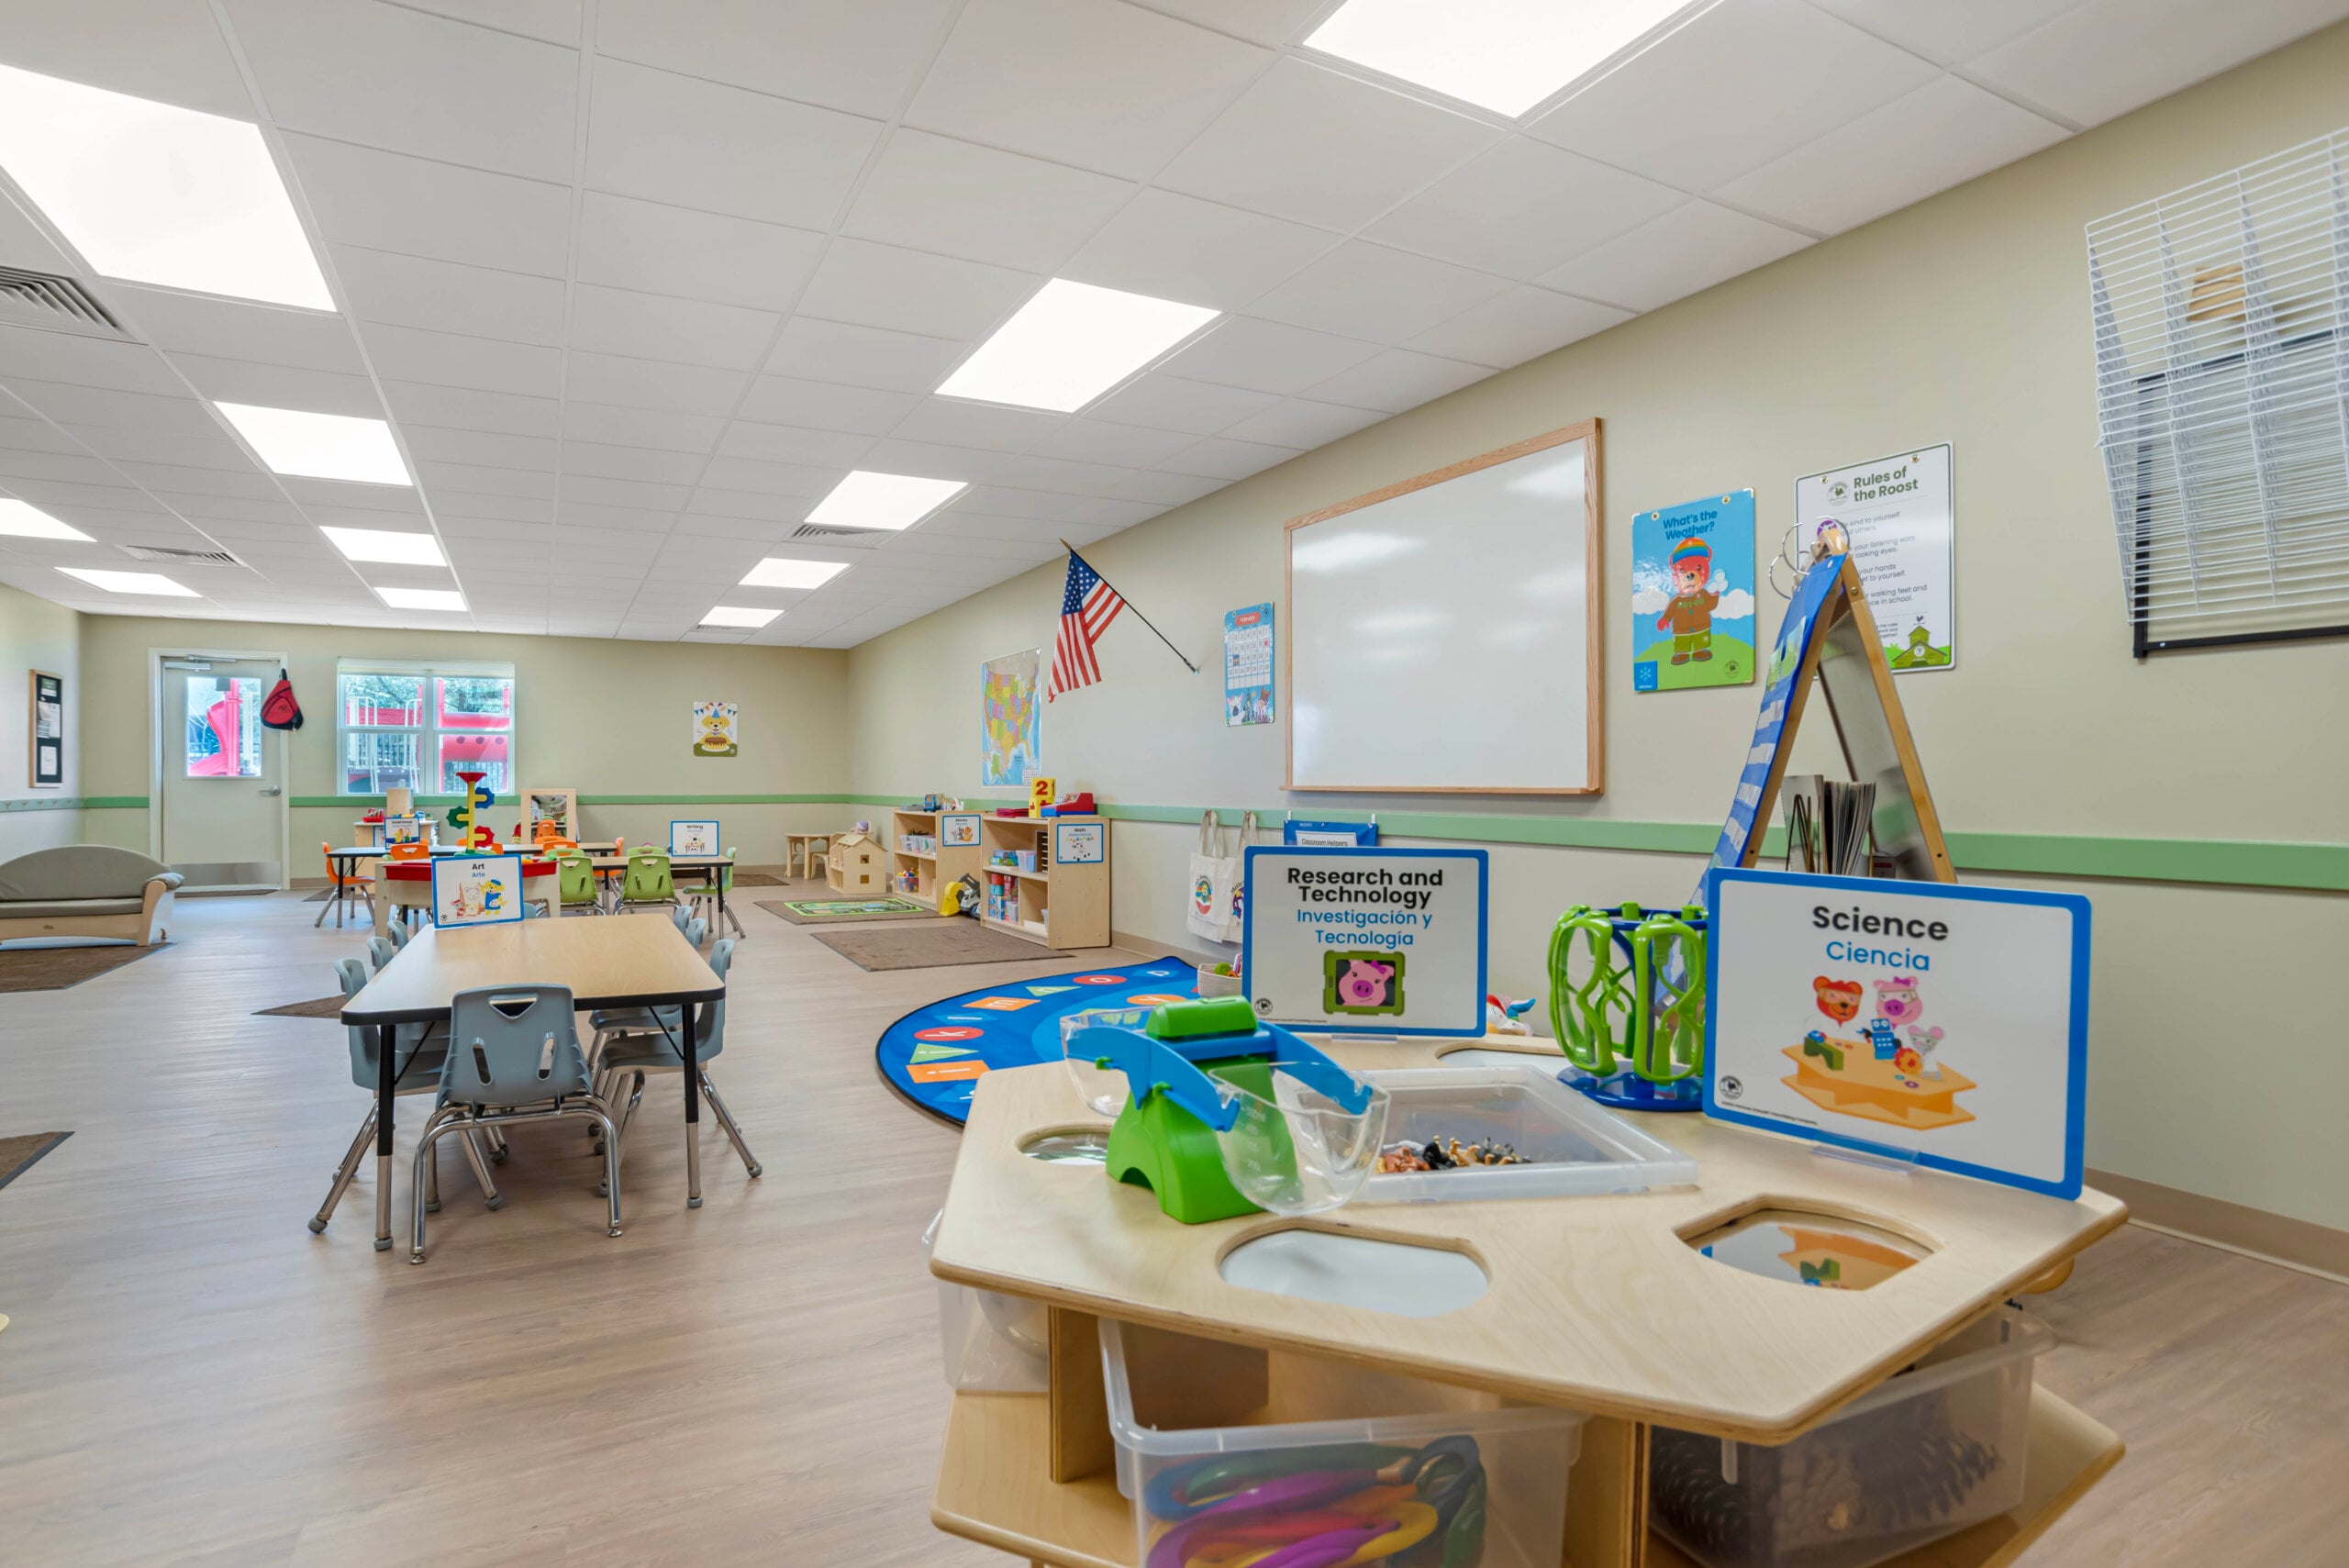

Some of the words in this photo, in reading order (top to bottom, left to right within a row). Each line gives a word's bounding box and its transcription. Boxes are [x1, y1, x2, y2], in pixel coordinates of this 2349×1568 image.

[1854, 473, 1890, 488] Rules
[1894, 466, 1907, 479] of
[1854, 490, 1876, 501] the
[1879, 479, 1918, 496] Roost
[1663, 514, 1698, 528] What's
[1700, 510, 1718, 521] the
[1874, 512, 1899, 522] yourself
[1665, 521, 1714, 540] Weather?
[1870, 538, 1898, 548] listening
[1855, 549, 1878, 559] looking
[1875, 563, 1896, 572] hands
[1871, 588, 1896, 597] walking
[1036, 781, 1048, 795] 2
[1287, 868, 1393, 886] Research
[1398, 870, 1442, 886] and
[1298, 886, 1431, 909] Technology
[1297, 908, 1417, 929] Investigación
[1422, 914, 1432, 929] y
[1812, 905, 1948, 941] Science
[1315, 929, 1413, 950] Tecnología
[1826, 941, 1930, 971] Ciencia
